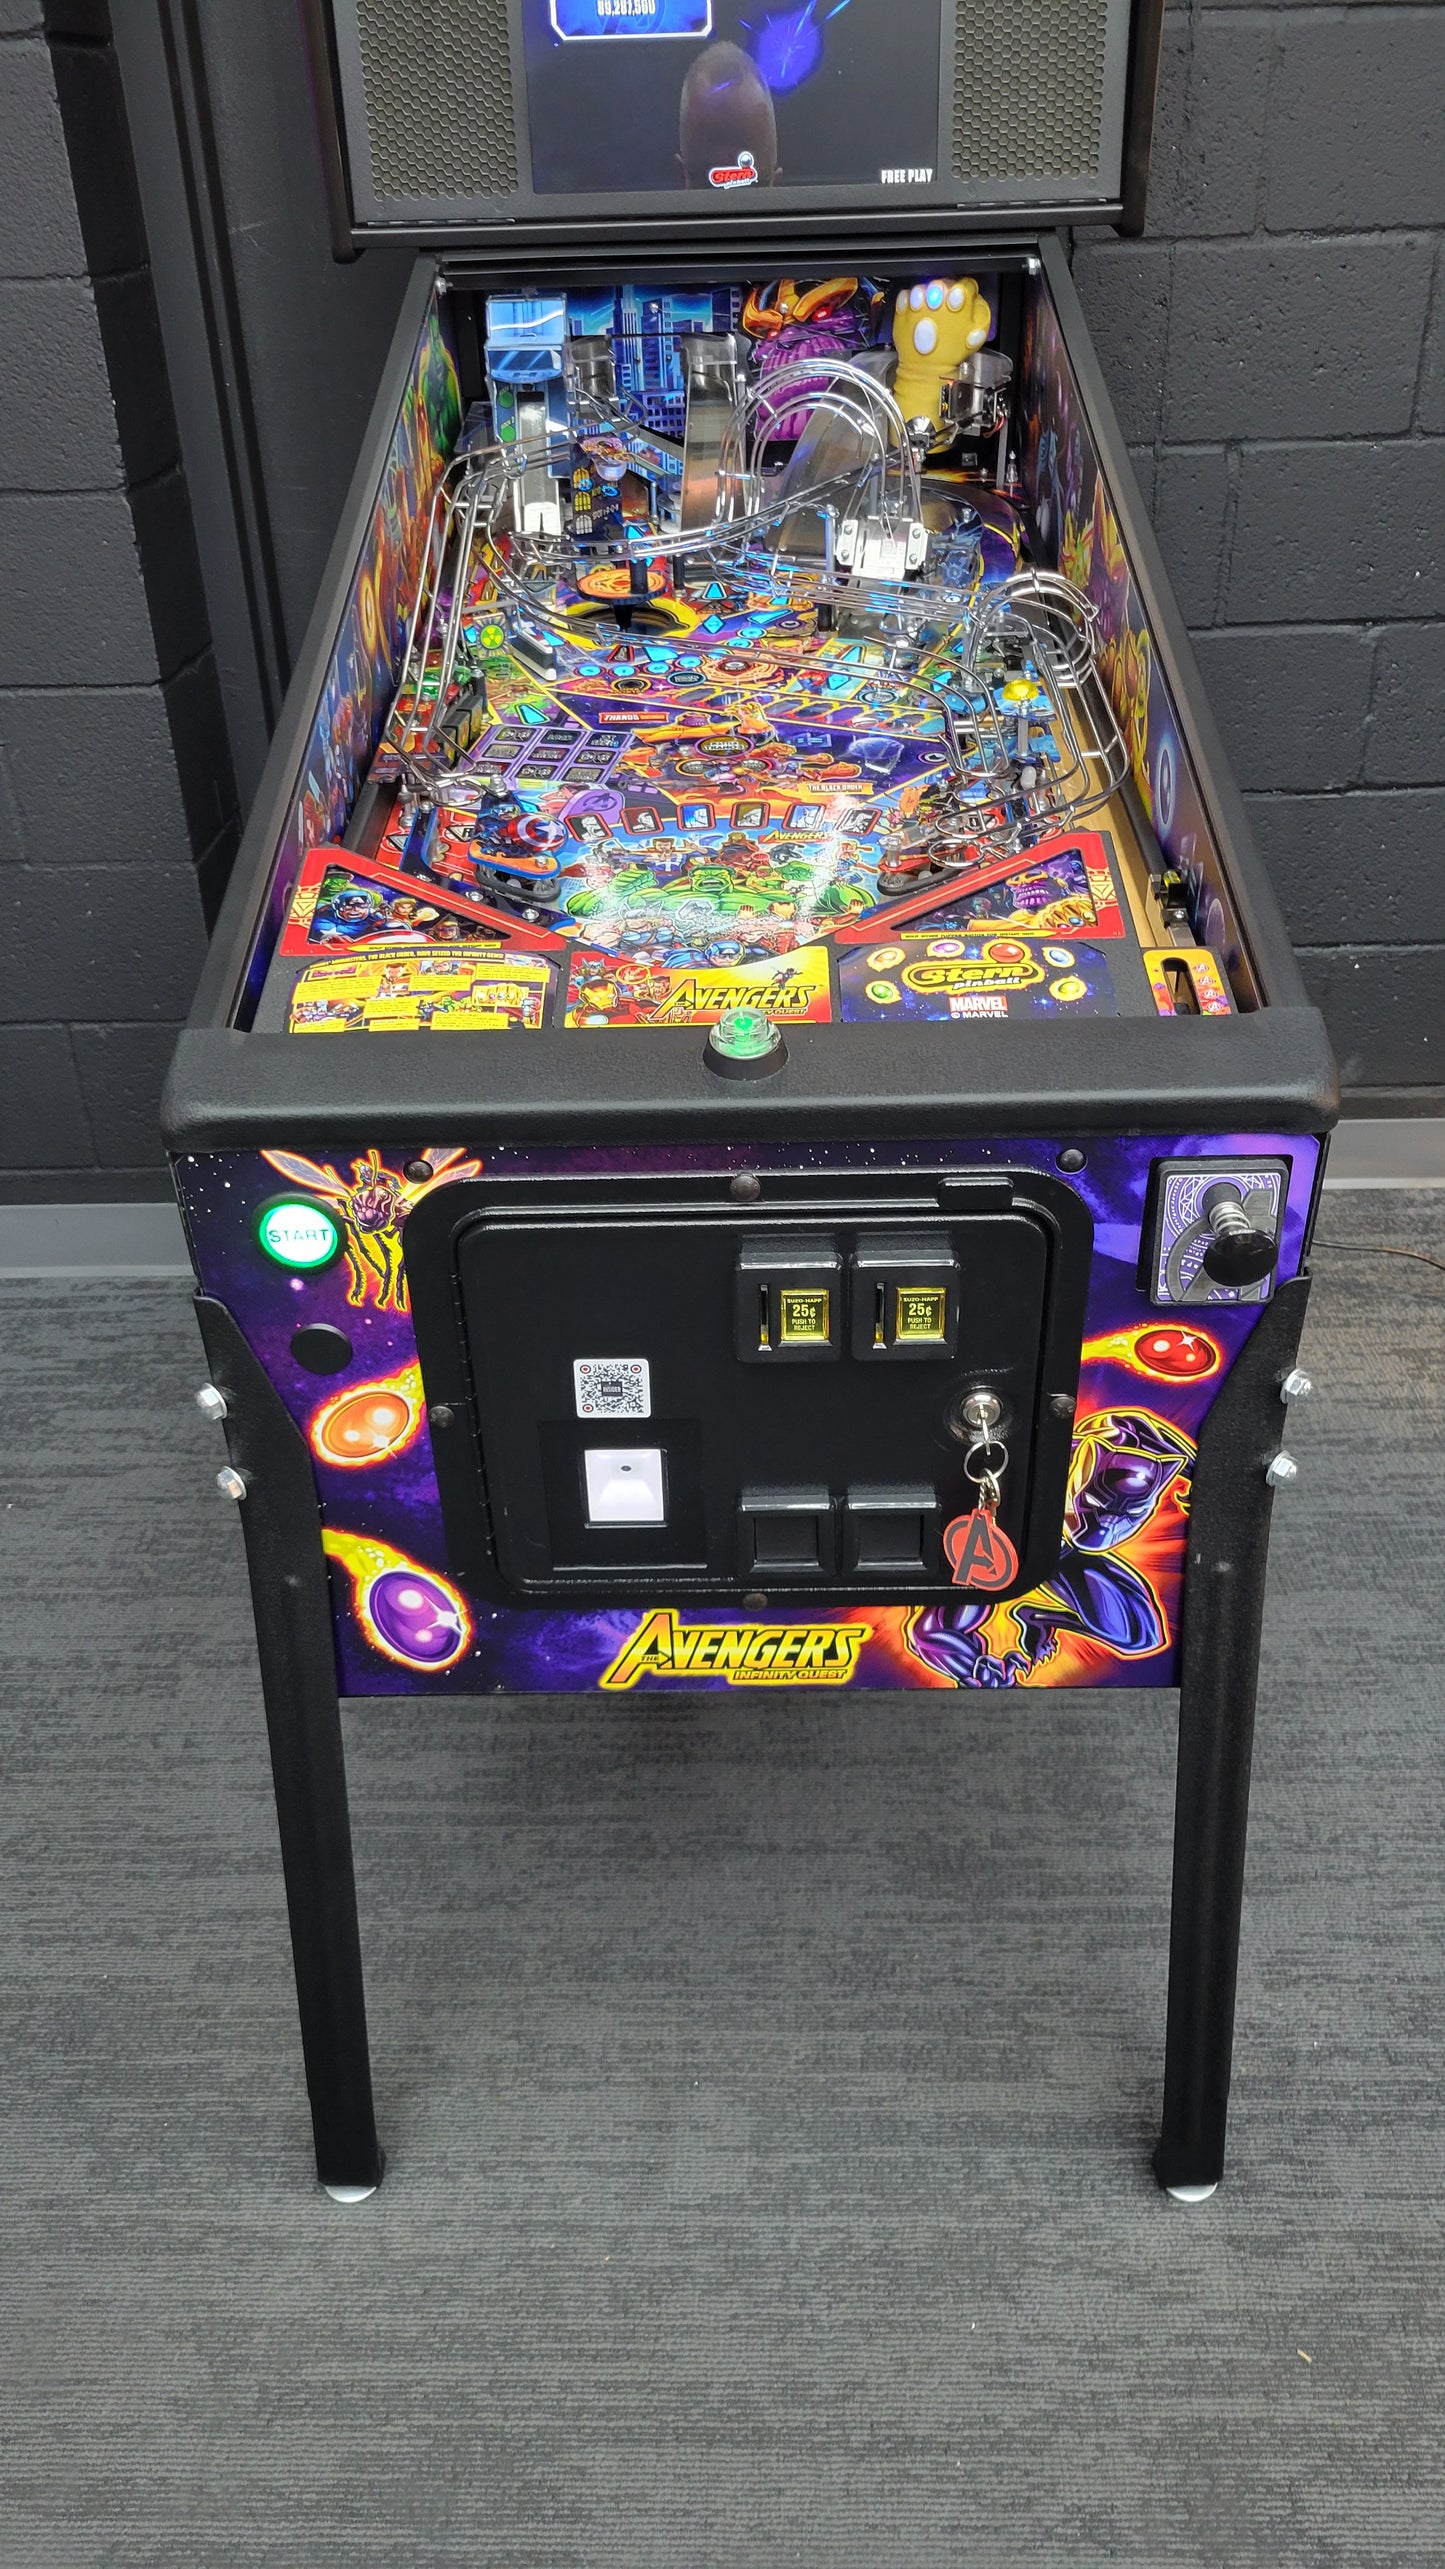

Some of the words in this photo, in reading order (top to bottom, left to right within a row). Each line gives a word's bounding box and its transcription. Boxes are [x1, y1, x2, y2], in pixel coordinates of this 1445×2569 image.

[881, 169, 906, 184] FREE
[908, 168, 933, 183] PLAY
[952, 976, 1021, 990] pinball
[650, 978, 817, 1020] AVENGERS
[951, 996, 1007, 1012] MARVEL
[268, 1228, 330, 1243] START
[792, 1304, 816, 1318] 25¢
[908, 1302, 932, 1317] 25¢
[607, 1612, 866, 1684] AVENGERS
[732, 1670, 797, 1680] INFINITY
[797, 1669, 846, 1680] QUEST
